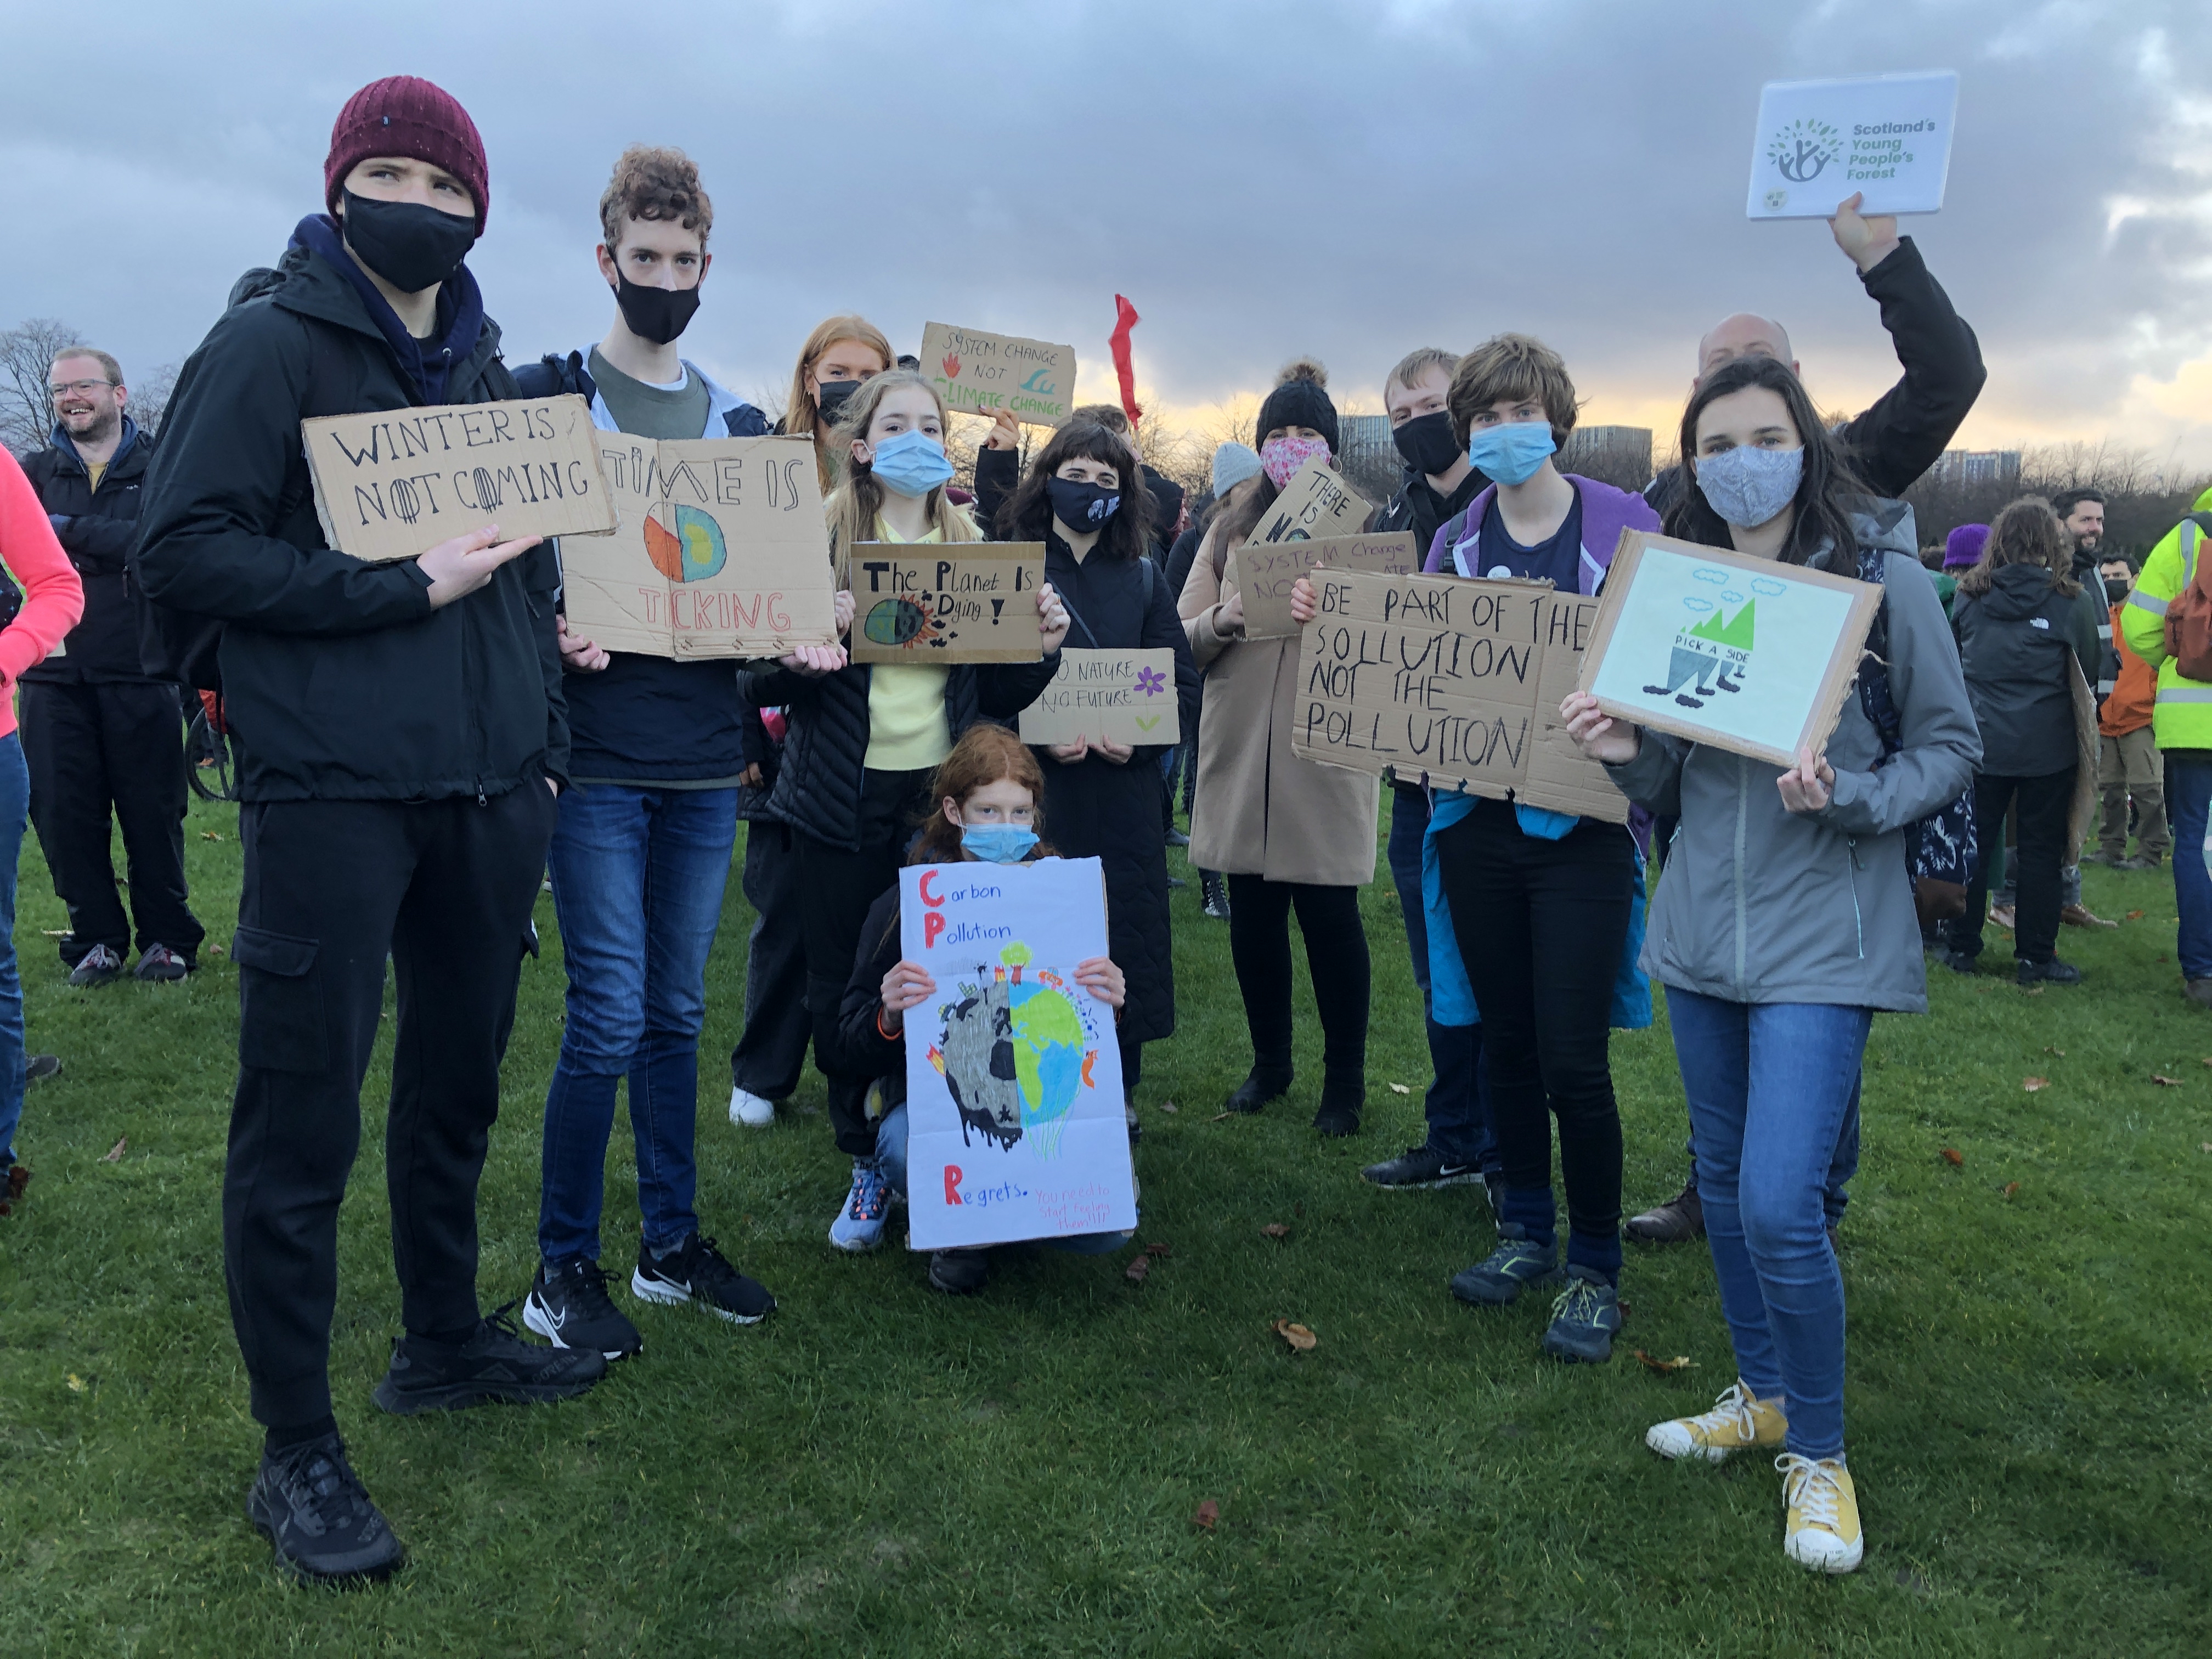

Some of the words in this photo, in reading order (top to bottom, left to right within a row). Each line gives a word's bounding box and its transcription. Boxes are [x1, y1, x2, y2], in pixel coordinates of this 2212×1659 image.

[1853, 117, 1936, 136] Scotland's
[1849, 151, 1914, 167] People's
[1852, 138, 1903, 153] Young
[1847, 166, 1895, 180] Forest
[943, 332, 996, 357] SYSTEM
[1005, 343, 1058, 366] CHANGE
[974, 364, 1007, 379] NOT
[1010, 396, 1064, 417] CHANGE
[331, 410, 515, 467] WINTER
[522, 408, 555, 439] IS
[354, 472, 440, 526] NOT
[453, 461, 589, 515] COMING
[766, 459, 803, 511] IS
[1309, 470, 1351, 517] THERE
[1299, 501, 1318, 524] IS
[1248, 545, 1339, 574] SYSTEM
[1351, 542, 1406, 562] Change
[862, 562, 918, 594] The
[936, 561, 1000, 593] Planet
[1015, 566, 1033, 591] Is
[1254, 573, 1310, 600] NO
[639, 588, 791, 632] TICKING
[1322, 583, 1353, 615] BE
[1385, 586, 1455, 624] PART
[1472, 595, 1513, 633] OF
[1530, 596, 1598, 652] THE
[1316, 624, 1531, 684] SOLLUTION
[1675, 635, 1704, 651] PICK
[1708, 645, 1717, 655] A
[1726, 648, 1750, 664] SIDE
[1053, 659, 1069, 682] O
[1078, 660, 1135, 681] NATURE
[1308, 661, 1359, 704] NOT
[1393, 668, 1449, 710] THE
[1042, 691, 1070, 713] NO
[1076, 689, 1132, 708] FUTURE
[1307, 702, 1528, 769] POLLUTION
[1035, 1188, 1057, 1205] You
[1062, 1181, 1094, 1202] need
[1098, 1183, 1109, 1195] to
